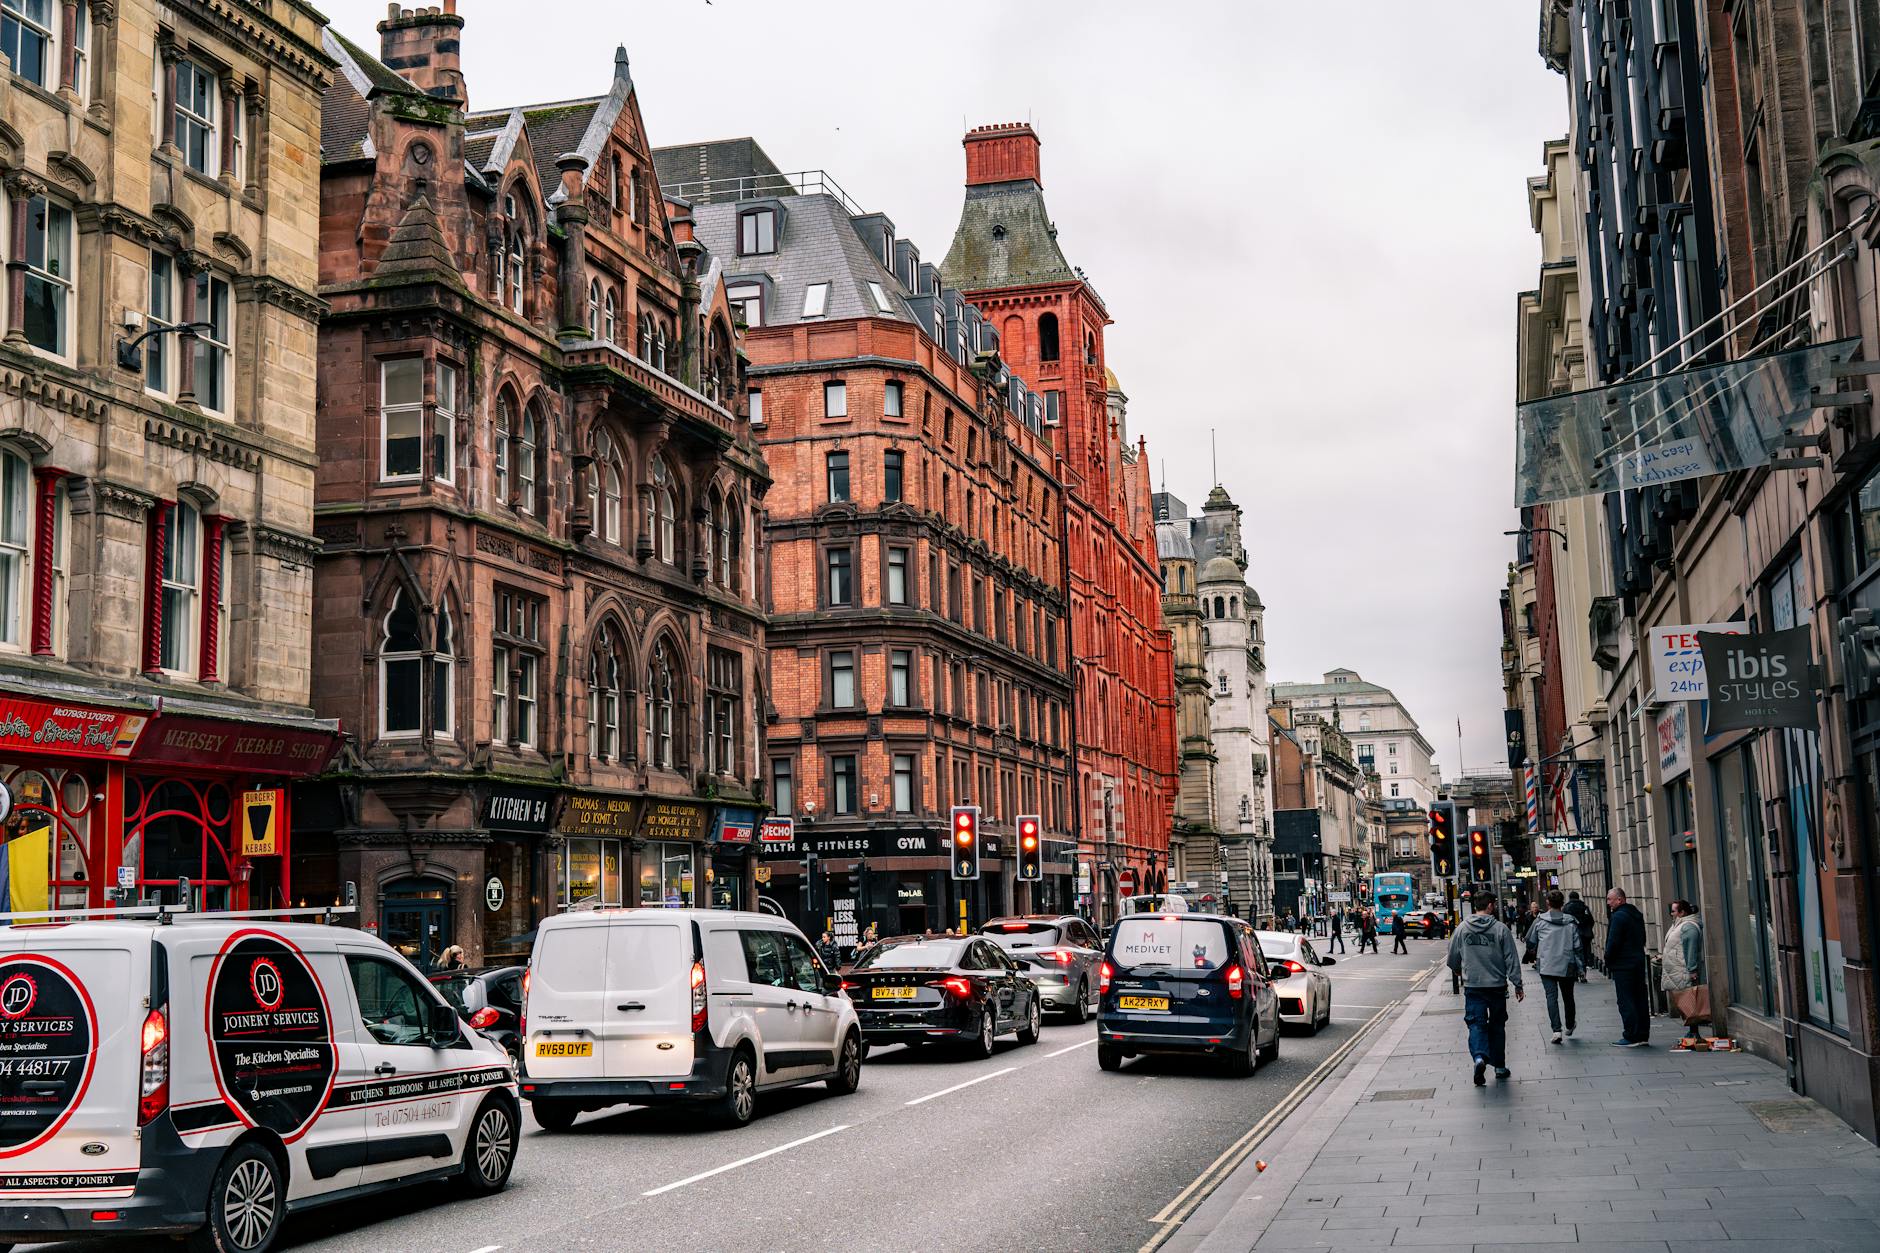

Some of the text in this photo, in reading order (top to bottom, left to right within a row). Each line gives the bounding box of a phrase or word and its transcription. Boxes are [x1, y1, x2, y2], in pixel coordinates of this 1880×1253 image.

[1726, 648, 1788, 680] ibis
[1670, 680, 1704, 693] 24hr
[87, 711, 115, 723] 170273
[84, 722, 119, 751] Food
[161, 729, 325, 760] MERSEY KEBAB SHOP
[245, 791, 275, 803] BURGERS
[490, 796, 548, 823] KITCHEN 54
[571, 797, 632, 813] THOMAS NELSON
[580, 811, 618, 826] LOKSMITS
[736, 828, 751, 838] ECHO
[768, 825, 790, 837] ECHO
[245, 842, 272, 853] KEBABS
[761, 839, 870, 853] ALTH & FITNESS
[897, 837, 927, 850] GYM
[833, 898, 856, 911] WISH
[833, 911, 857, 923] LESS,
[834, 923, 859, 935] WORK
[835, 935, 859, 947] MORE
[1125, 945, 1172, 954] MEDIVET
[259, 973, 277, 996] JD
[6, 987, 29, 1007] JD
[875, 988, 913, 997] BV74 RXP
[1123, 996, 1165, 1008] AK22 RXY
[13, 1020, 74, 1034] SERVICES
[224, 1012, 320, 1033] JOINERY SERVICES
[13, 1041, 48, 1053] Specialists
[539, 1043, 587, 1055] RV69 OYF
[235, 1046, 320, 1066] The Kitchen Specialists
[0, 1060, 71, 1076] 04 448177
[350, 1069, 505, 1101] KITCHENS BEDROOMS ALL ASPECTS OF JOINERY
[374, 1101, 452, 1128] Tel 07504 448177
[5, 1175, 116, 1187] ALL ASPECTS OF JOINERY
